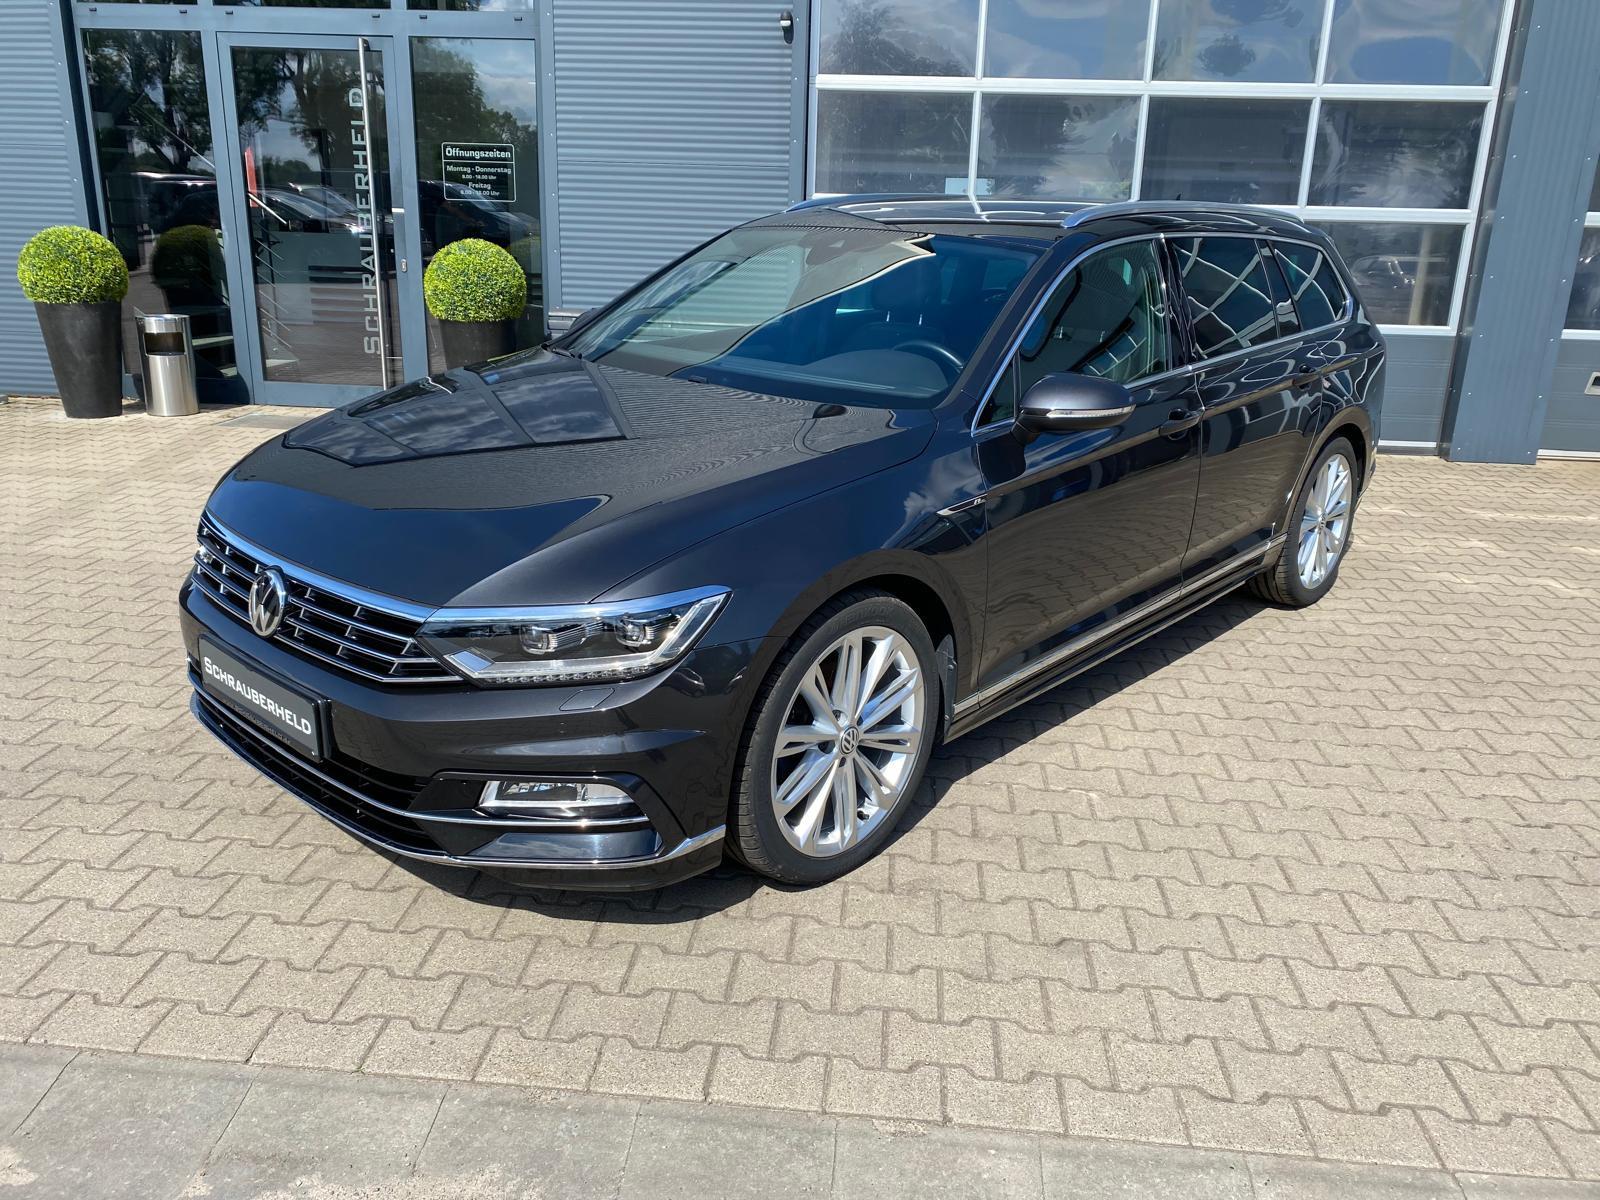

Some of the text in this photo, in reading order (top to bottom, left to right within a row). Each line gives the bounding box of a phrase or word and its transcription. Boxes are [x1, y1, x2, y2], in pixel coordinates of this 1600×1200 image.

[446, 146, 510, 159] Öffnungszeiten
[446, 165, 471, 173] Montag
[476, 166, 511, 174] Donnerstag
[469, 182, 491, 190] Freitag
[203, 656, 312, 735] SCHRAUBERHELD
